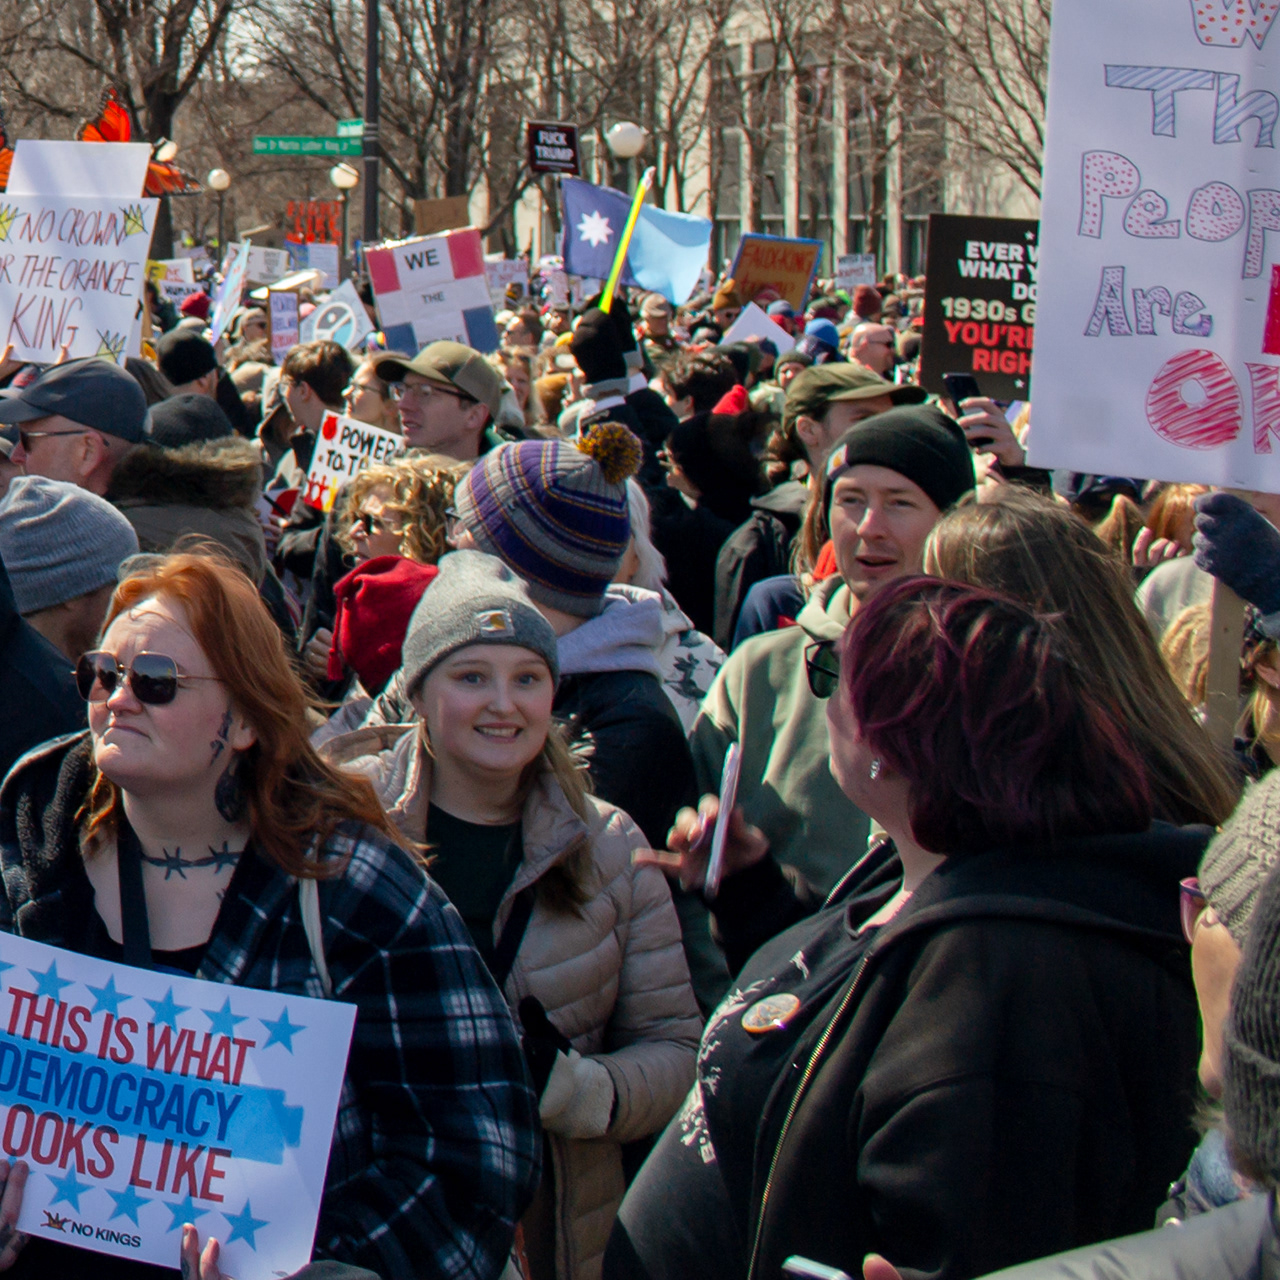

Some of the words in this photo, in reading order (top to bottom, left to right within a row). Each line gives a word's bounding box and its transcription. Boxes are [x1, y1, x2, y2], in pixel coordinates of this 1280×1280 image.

[1104, 64, 1279, 148] Th
[538, 130, 567, 145] FUCK
[535, 145, 574, 161] TRUMP
[19, 207, 56, 244] NO
[57, 207, 127, 247] CROWN
[1078, 151, 1280, 279] Peop
[404, 249, 440, 270] WE
[965, 240, 1024, 262] EVER
[18, 254, 62, 289] THE
[59, 259, 140, 297] ORANGE
[957, 259, 1024, 281] WHAT
[421, 291, 445, 304] THE
[941, 296, 1017, 322] 1930s
[1083, 266, 1213, 337] Are
[7, 292, 83, 352] KING
[972, 347, 1033, 375] RIGH
[6, 986, 93, 1054] THIS
[97, 1012, 139, 1064] IS
[146, 1021, 256, 1086] WHAT
[129, 1133, 232, 1203] LIKE
[71, 1221, 94, 1237] NO
[95, 1227, 142, 1248] KINGS
